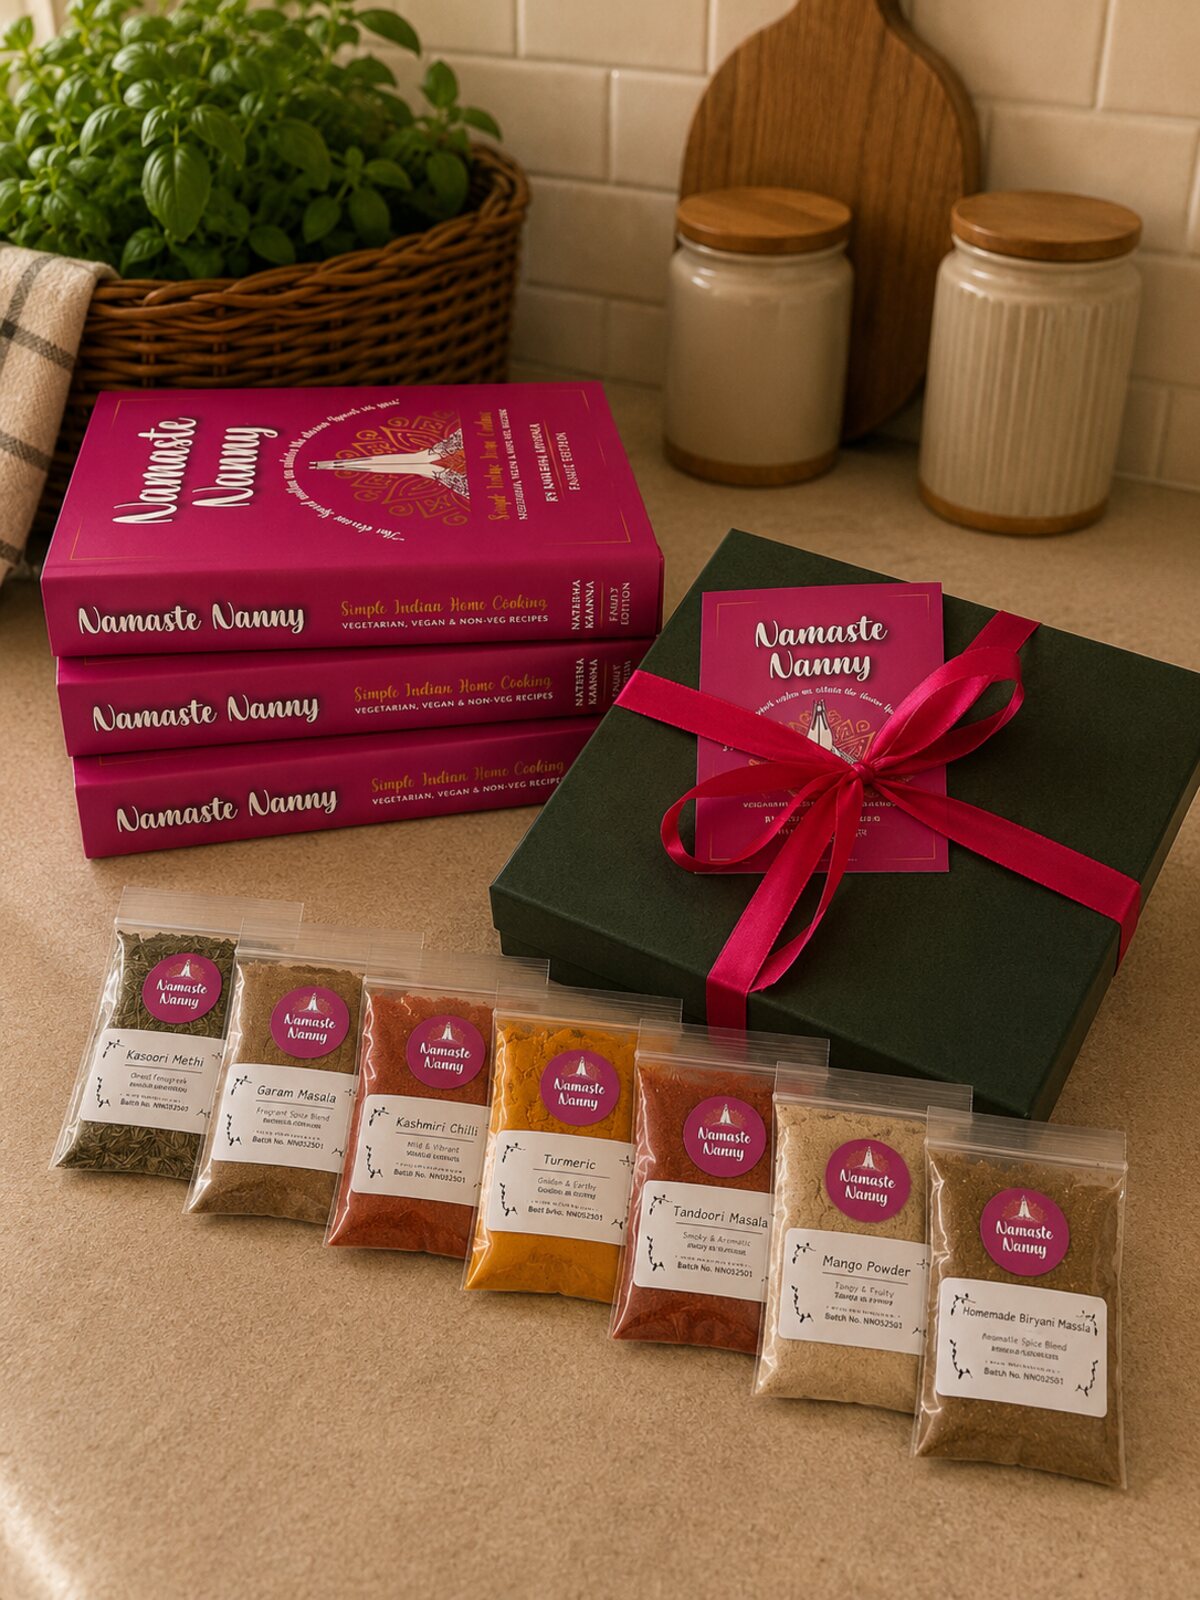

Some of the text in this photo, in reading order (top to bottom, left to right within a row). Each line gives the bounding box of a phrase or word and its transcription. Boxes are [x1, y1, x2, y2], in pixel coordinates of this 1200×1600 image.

[112, 417, 197, 524] Namaste
[192, 427, 279, 507] Nanny
[341, 594, 548, 619] Simple Indian Home Cooking
[78, 602, 304, 635] Namaste Nanny
[342, 620, 408, 630] VEGETARIAN,
[411, 618, 445, 627] VEGAN
[459, 615, 506, 625] NON-VEG
[509, 614, 549, 623] RECIPES
[755, 616, 888, 648] Namaste
[769, 650, 871, 681] Nanny
[354, 674, 552, 703] Simple Indian Home Cooking
[93, 694, 319, 732] Namaste Nanny
[354, 703, 419, 714] VEGETARIAN,
[421, 700, 454, 709] VEGAN
[467, 696, 513, 706] NON-VEG
[515, 692, 553, 702] RECIPES
[371, 761, 564, 793] Simple Indian Home Cooking
[372, 794, 434, 805] VEGETARIAN,
[437, 789, 470, 798] VEGAN
[482, 780, 526, 792] NON-VEG
[116, 789, 337, 833] Namaste Nanny
[157, 979, 207, 994] Namaste
[160, 993, 200, 1009] Nanny
[284, 1013, 336, 1029] Namaste
[288, 1027, 328, 1044] Nanny
[127, 1050, 204, 1067] Kasoori Methi
[420, 1042, 472, 1059] Namaste
[424, 1058, 464, 1074] Nanny
[257, 1085, 337, 1103] Garam Masala
[554, 1078, 605, 1095] Namaste
[558, 1093, 598, 1111] Nanny
[396, 1117, 478, 1137] Kashmiri Chilli
[698, 1127, 751, 1143] Namaste
[703, 1142, 744, 1161] Nanny
[544, 1154, 596, 1170] Turmeric
[840, 1169, 896, 1189] Namaste
[845, 1186, 888, 1207] Nanny
[674, 1205, 768, 1228] Tandoori Masala
[996, 1221, 1053, 1240] Namaste
[1002, 1237, 1047, 1259] Nanny
[823, 1255, 911, 1277] Mango Powder
[963, 1306, 1016, 1322] Homemade
[1019, 1314, 1055, 1328] Biryani
